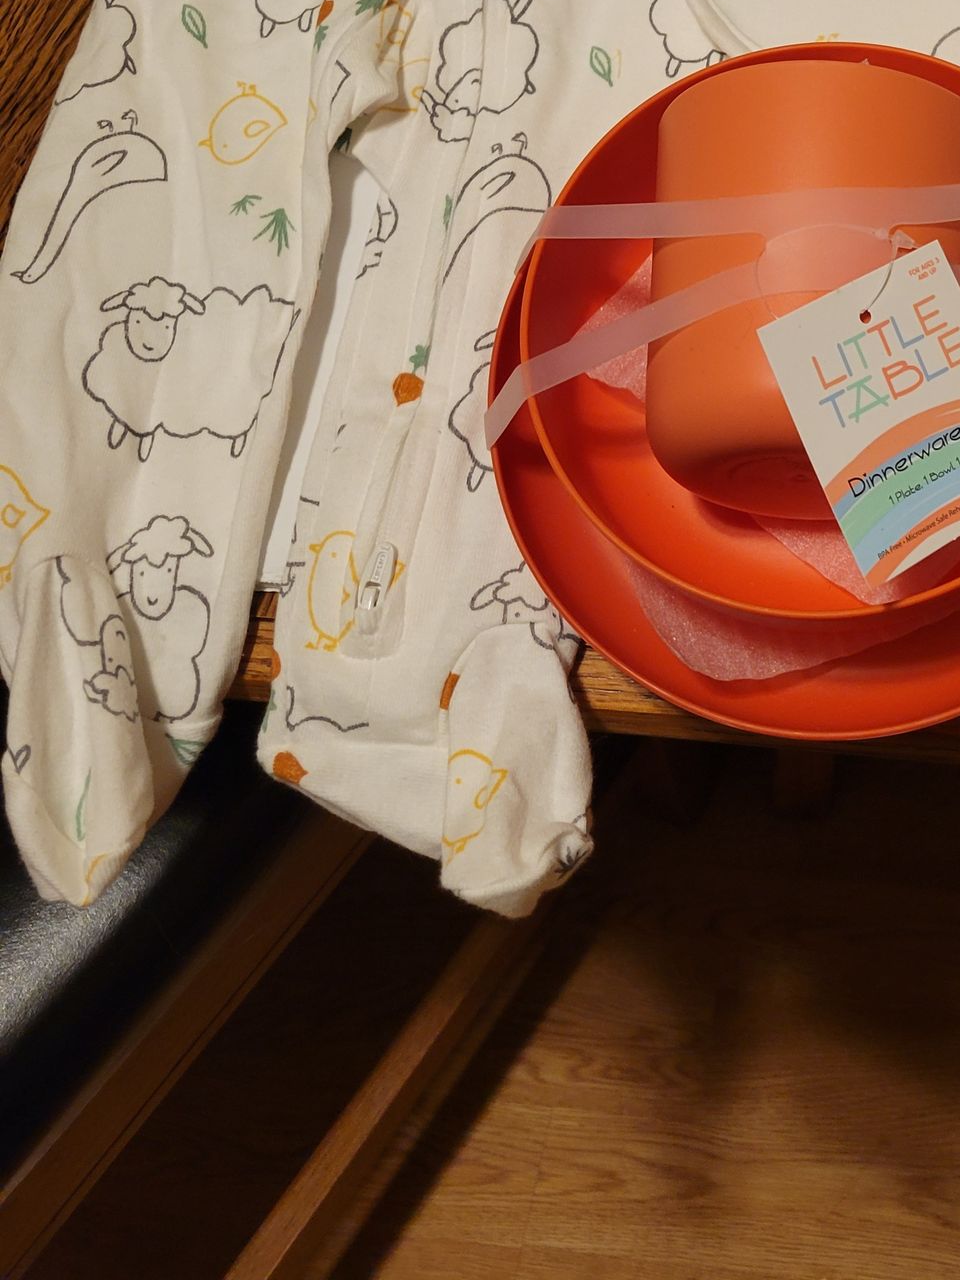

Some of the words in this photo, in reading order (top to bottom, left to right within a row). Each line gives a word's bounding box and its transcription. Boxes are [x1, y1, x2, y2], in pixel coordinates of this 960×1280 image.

[812, 294, 948, 390] LITTLE
[905, 520, 936, 544] Microwave
[935, 512, 949, 525] Safe
